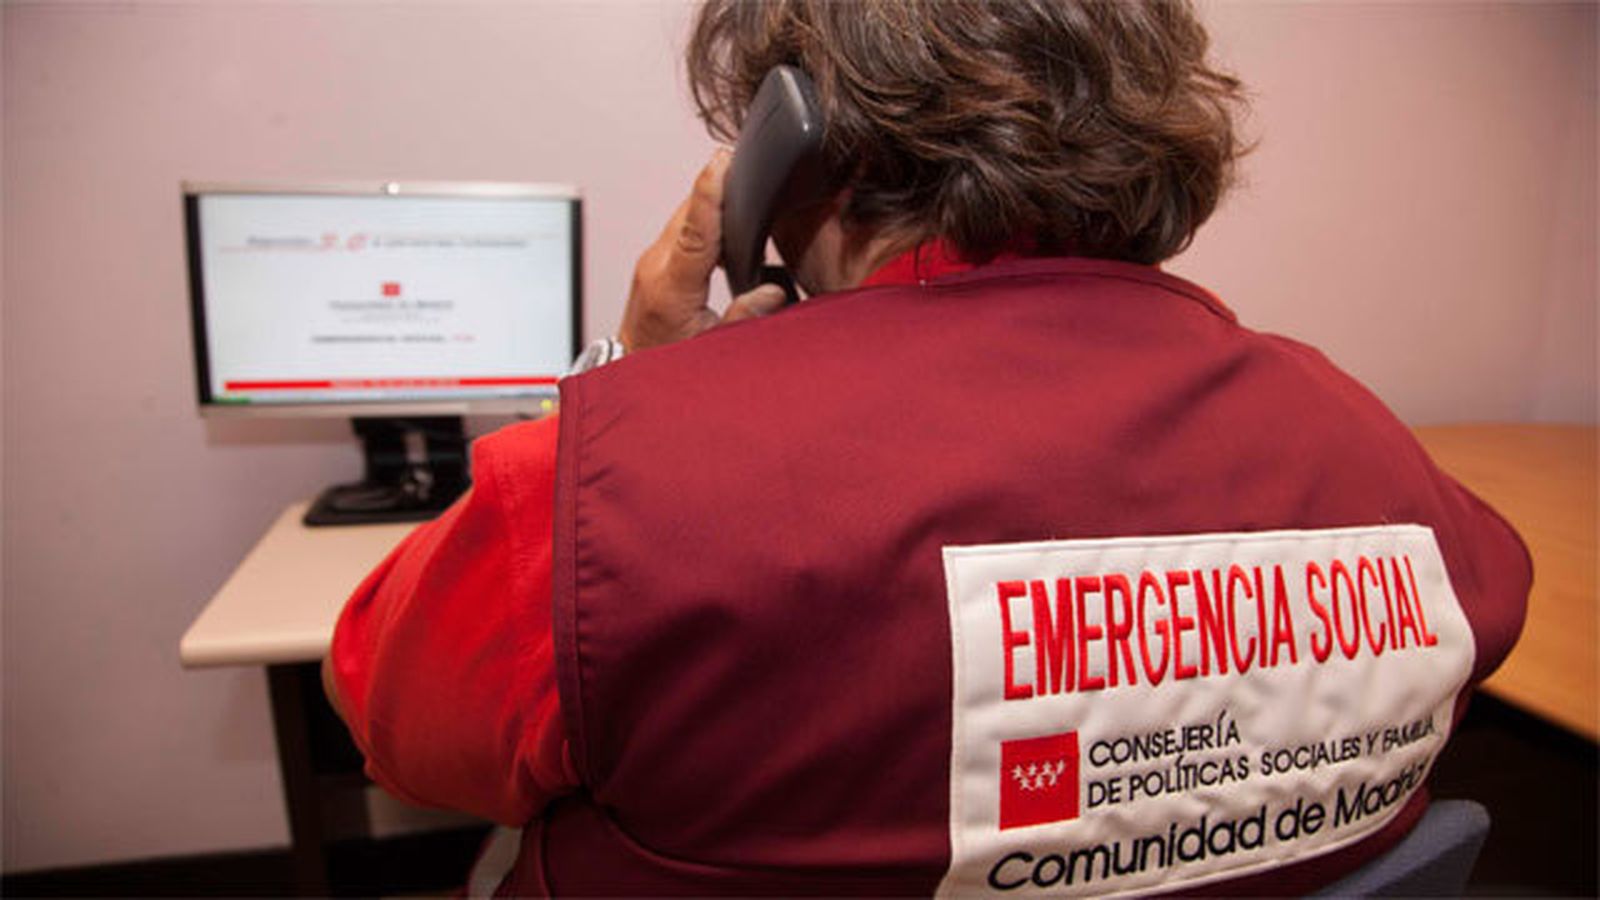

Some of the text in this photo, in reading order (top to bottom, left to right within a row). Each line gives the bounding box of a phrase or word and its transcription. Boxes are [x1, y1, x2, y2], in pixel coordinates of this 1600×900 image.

[997, 555, 1438, 700] EMERGENCIA SOCIAL
[1087, 777, 1122, 808] DE
[1129, 755, 1250, 801] POLÍTICAS
[1260, 736, 1361, 776] SOCIALES
[1366, 730, 1380, 756] Y
[1088, 709, 1241, 767] CONSEJERÍA
[988, 805, 1268, 890] Comunidad
[1275, 797, 1326, 841] de
